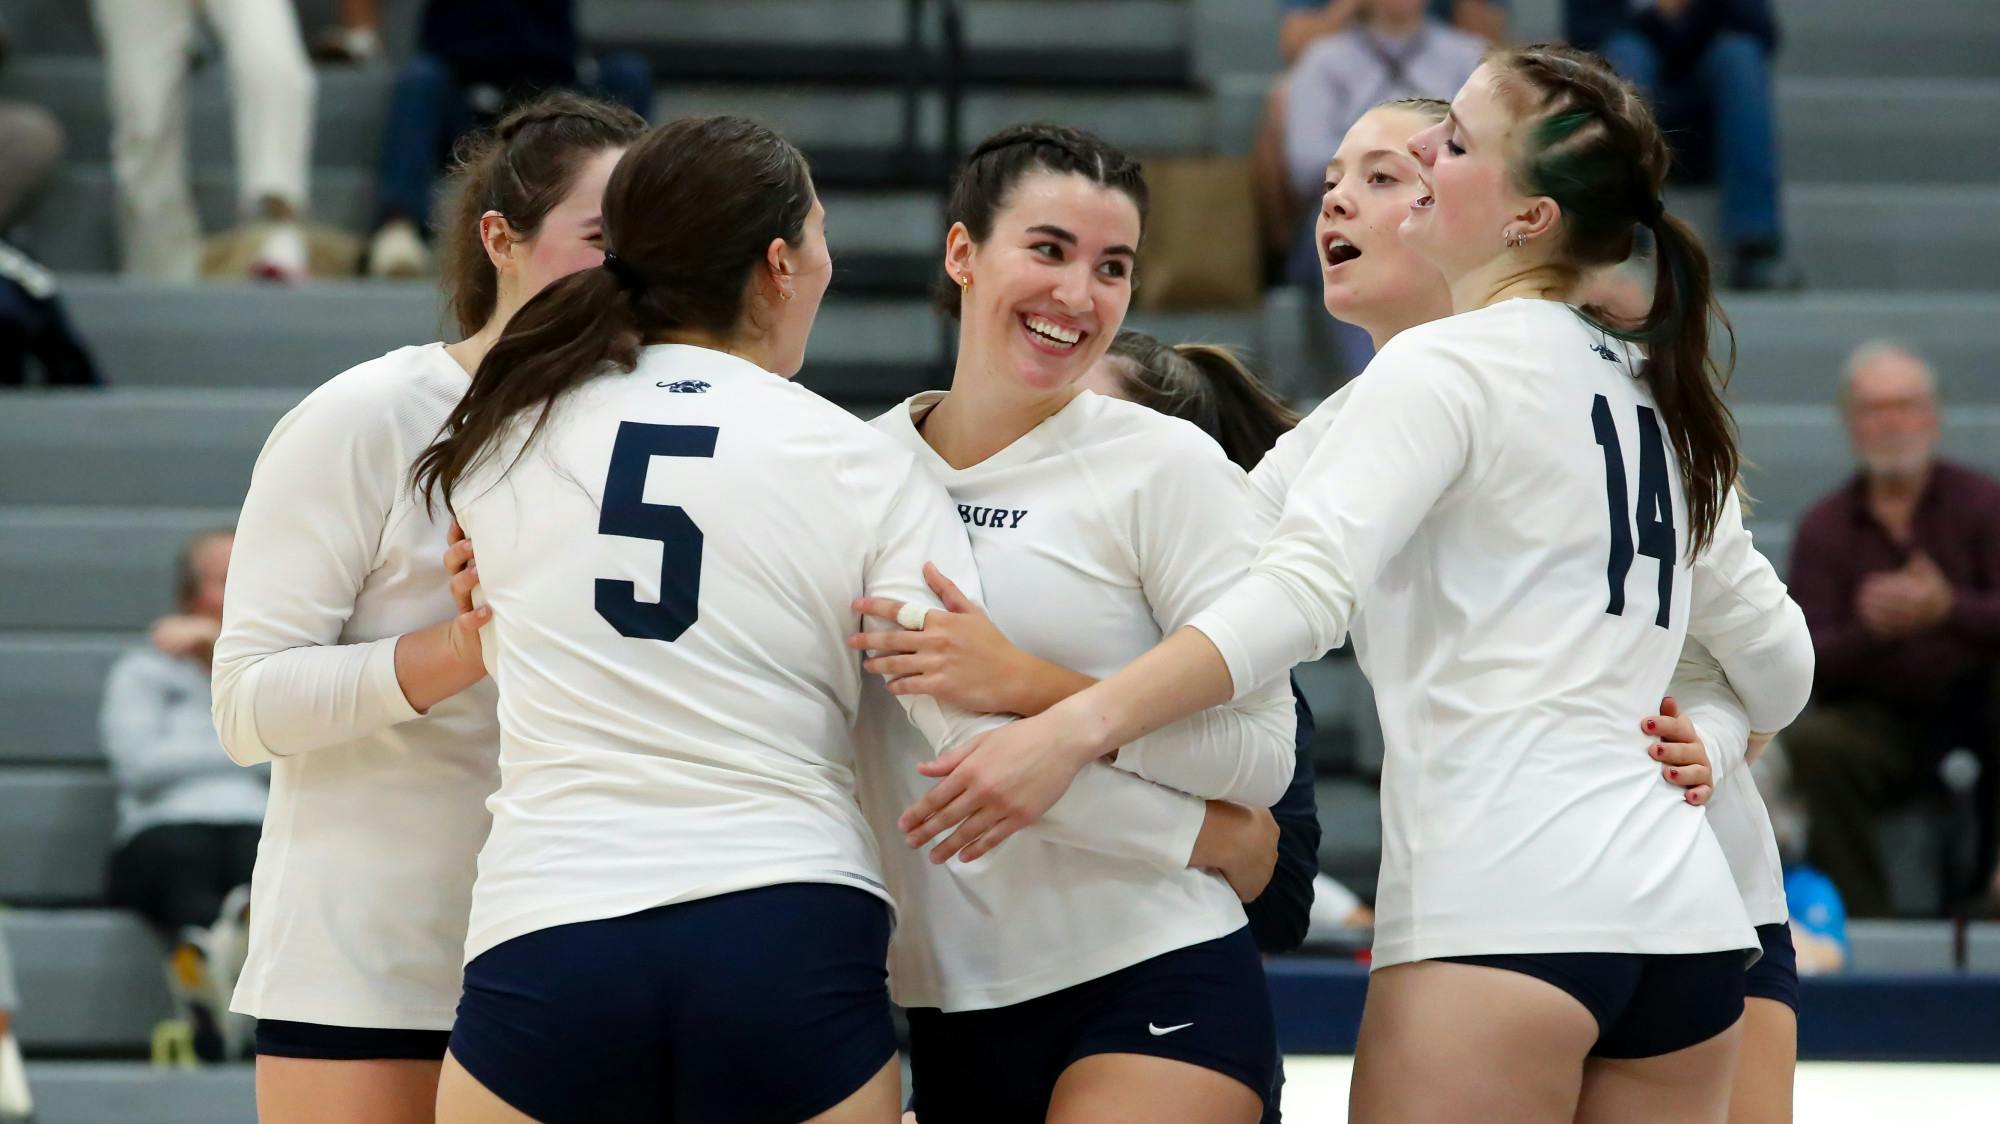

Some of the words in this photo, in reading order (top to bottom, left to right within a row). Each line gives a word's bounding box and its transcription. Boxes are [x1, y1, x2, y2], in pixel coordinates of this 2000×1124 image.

[595, 421, 720, 642] 5
[957, 504, 1028, 528] BURY
[1591, 393, 1676, 630] 14
